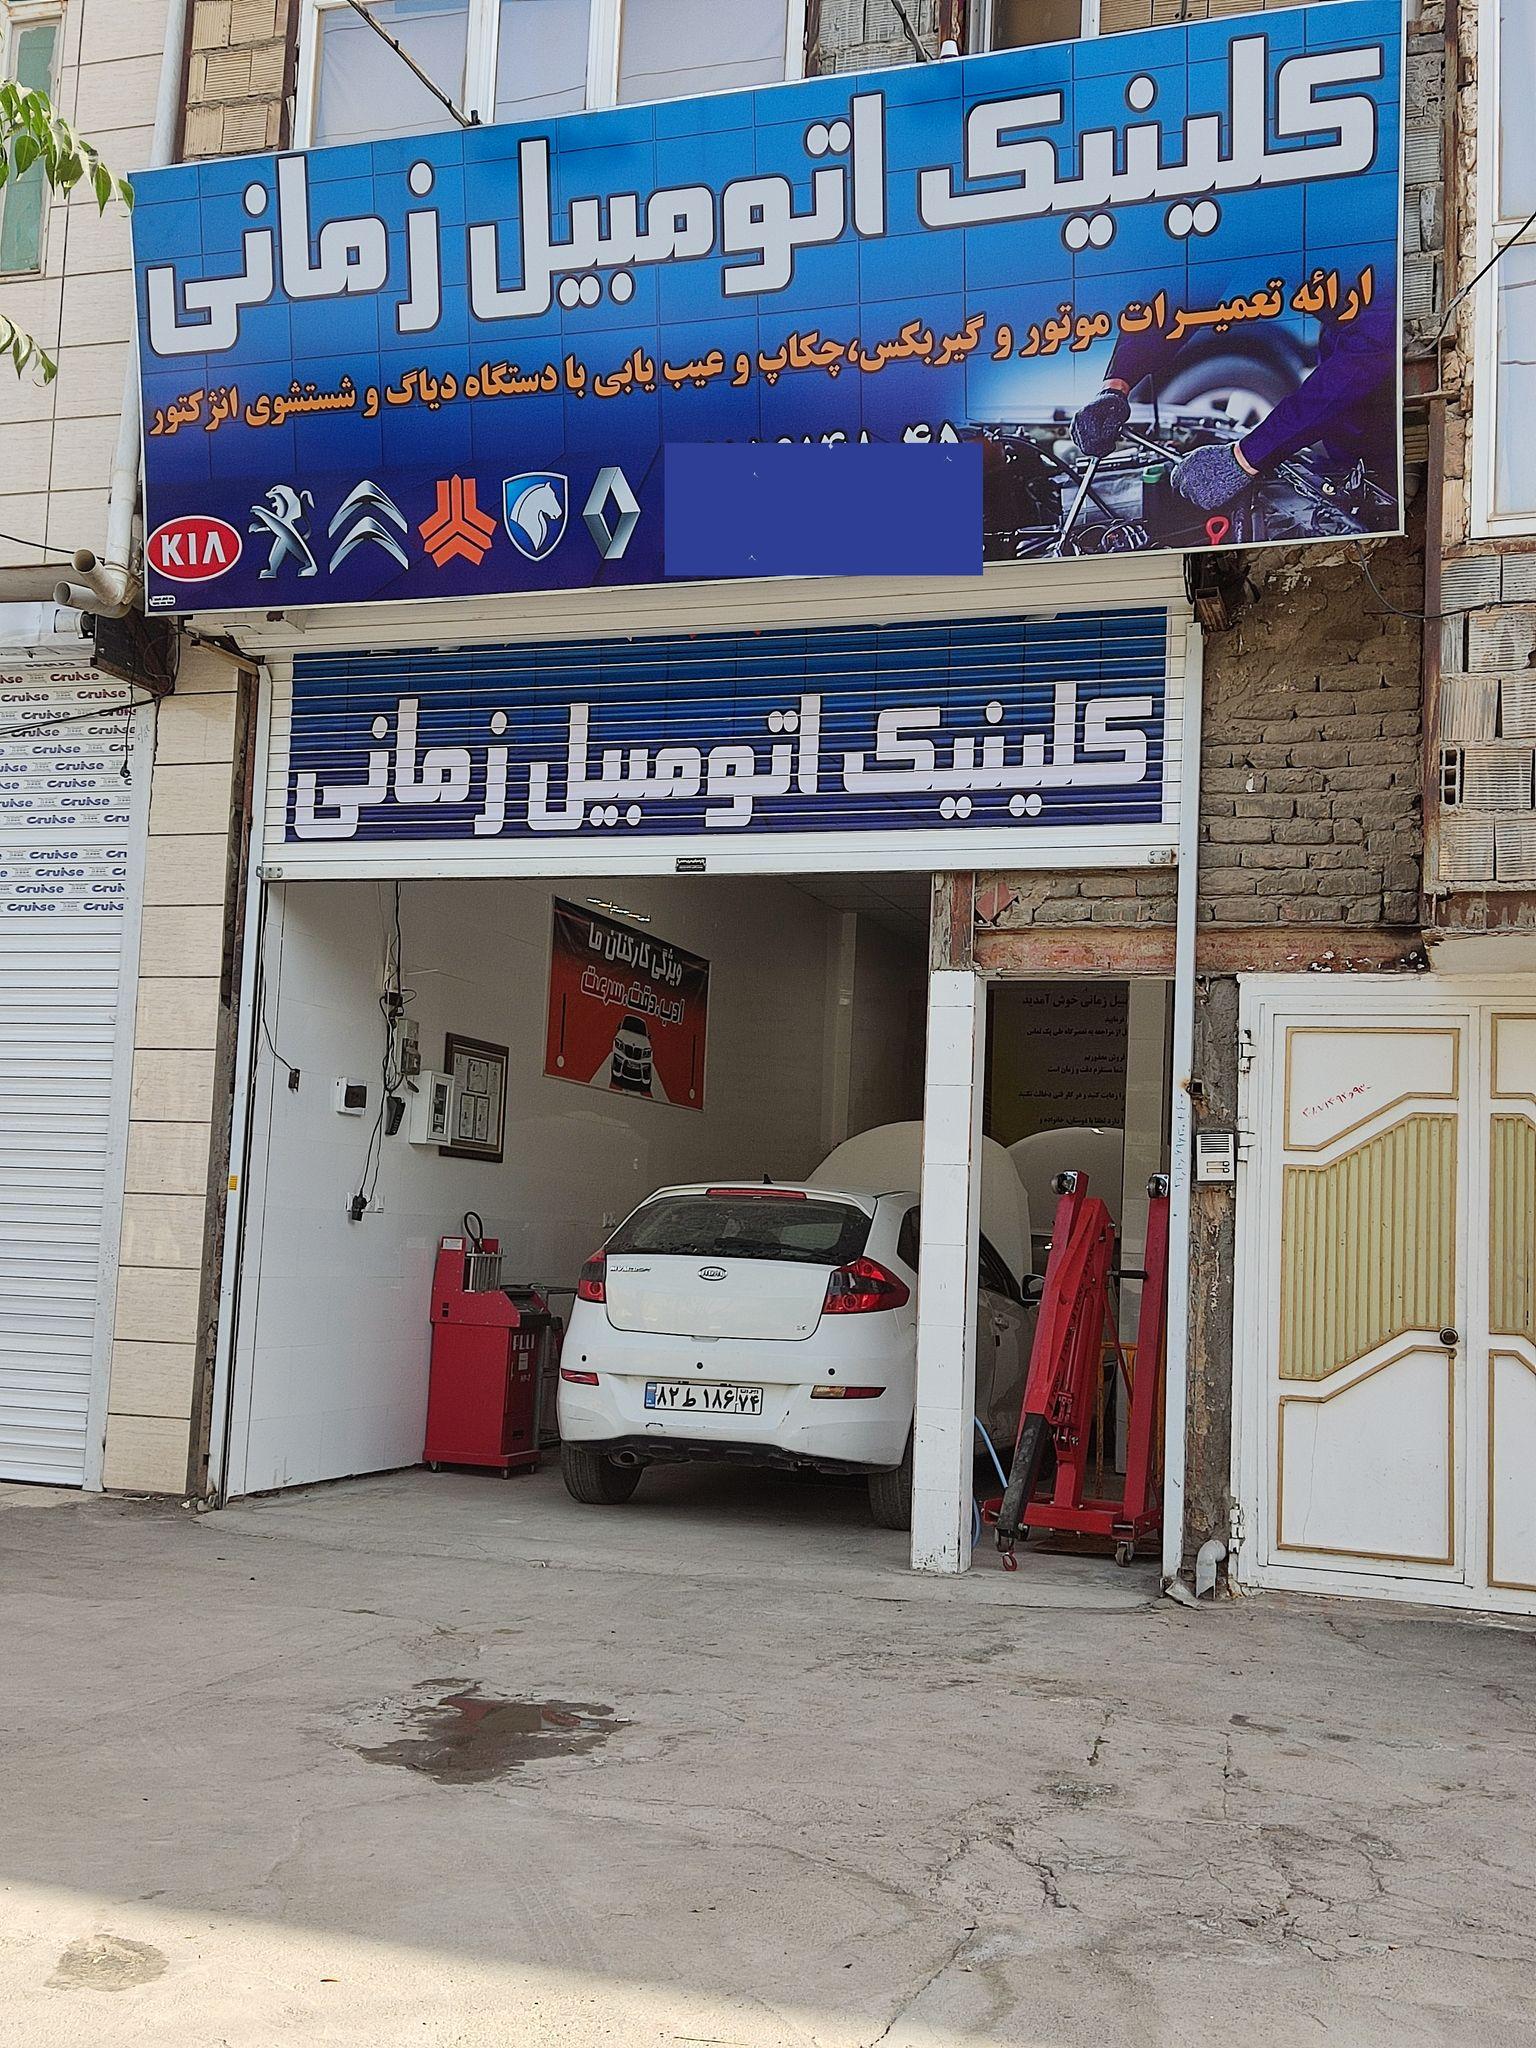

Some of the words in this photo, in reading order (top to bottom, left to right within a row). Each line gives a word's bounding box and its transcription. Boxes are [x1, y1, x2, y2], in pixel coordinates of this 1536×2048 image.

[920, 35, 1384, 250] کلینیک
[469, 92, 886, 321] اتومبیل
[146, 154, 442, 356] زمانی
[993, 325, 1013, 360] و
[1019, 303, 1111, 357] موتور
[386, 368, 457, 409] دیاگ
[464, 360, 558, 398] دستگاه
[564, 355, 586, 398] با
[593, 347, 655, 398] یابی
[662, 350, 724, 388] عیب
[731, 353, 750, 385] و
[245, 376, 355, 426] شستشوی
[362, 385, 378, 417] و
[160, 531, 227, 567] KIA
[294, 698, 509, 839] زمانی
[527, 693, 821, 831] اتومبیل
[843, 680, 1154, 820] کلینیک
[588, 921, 603, 951] ما
